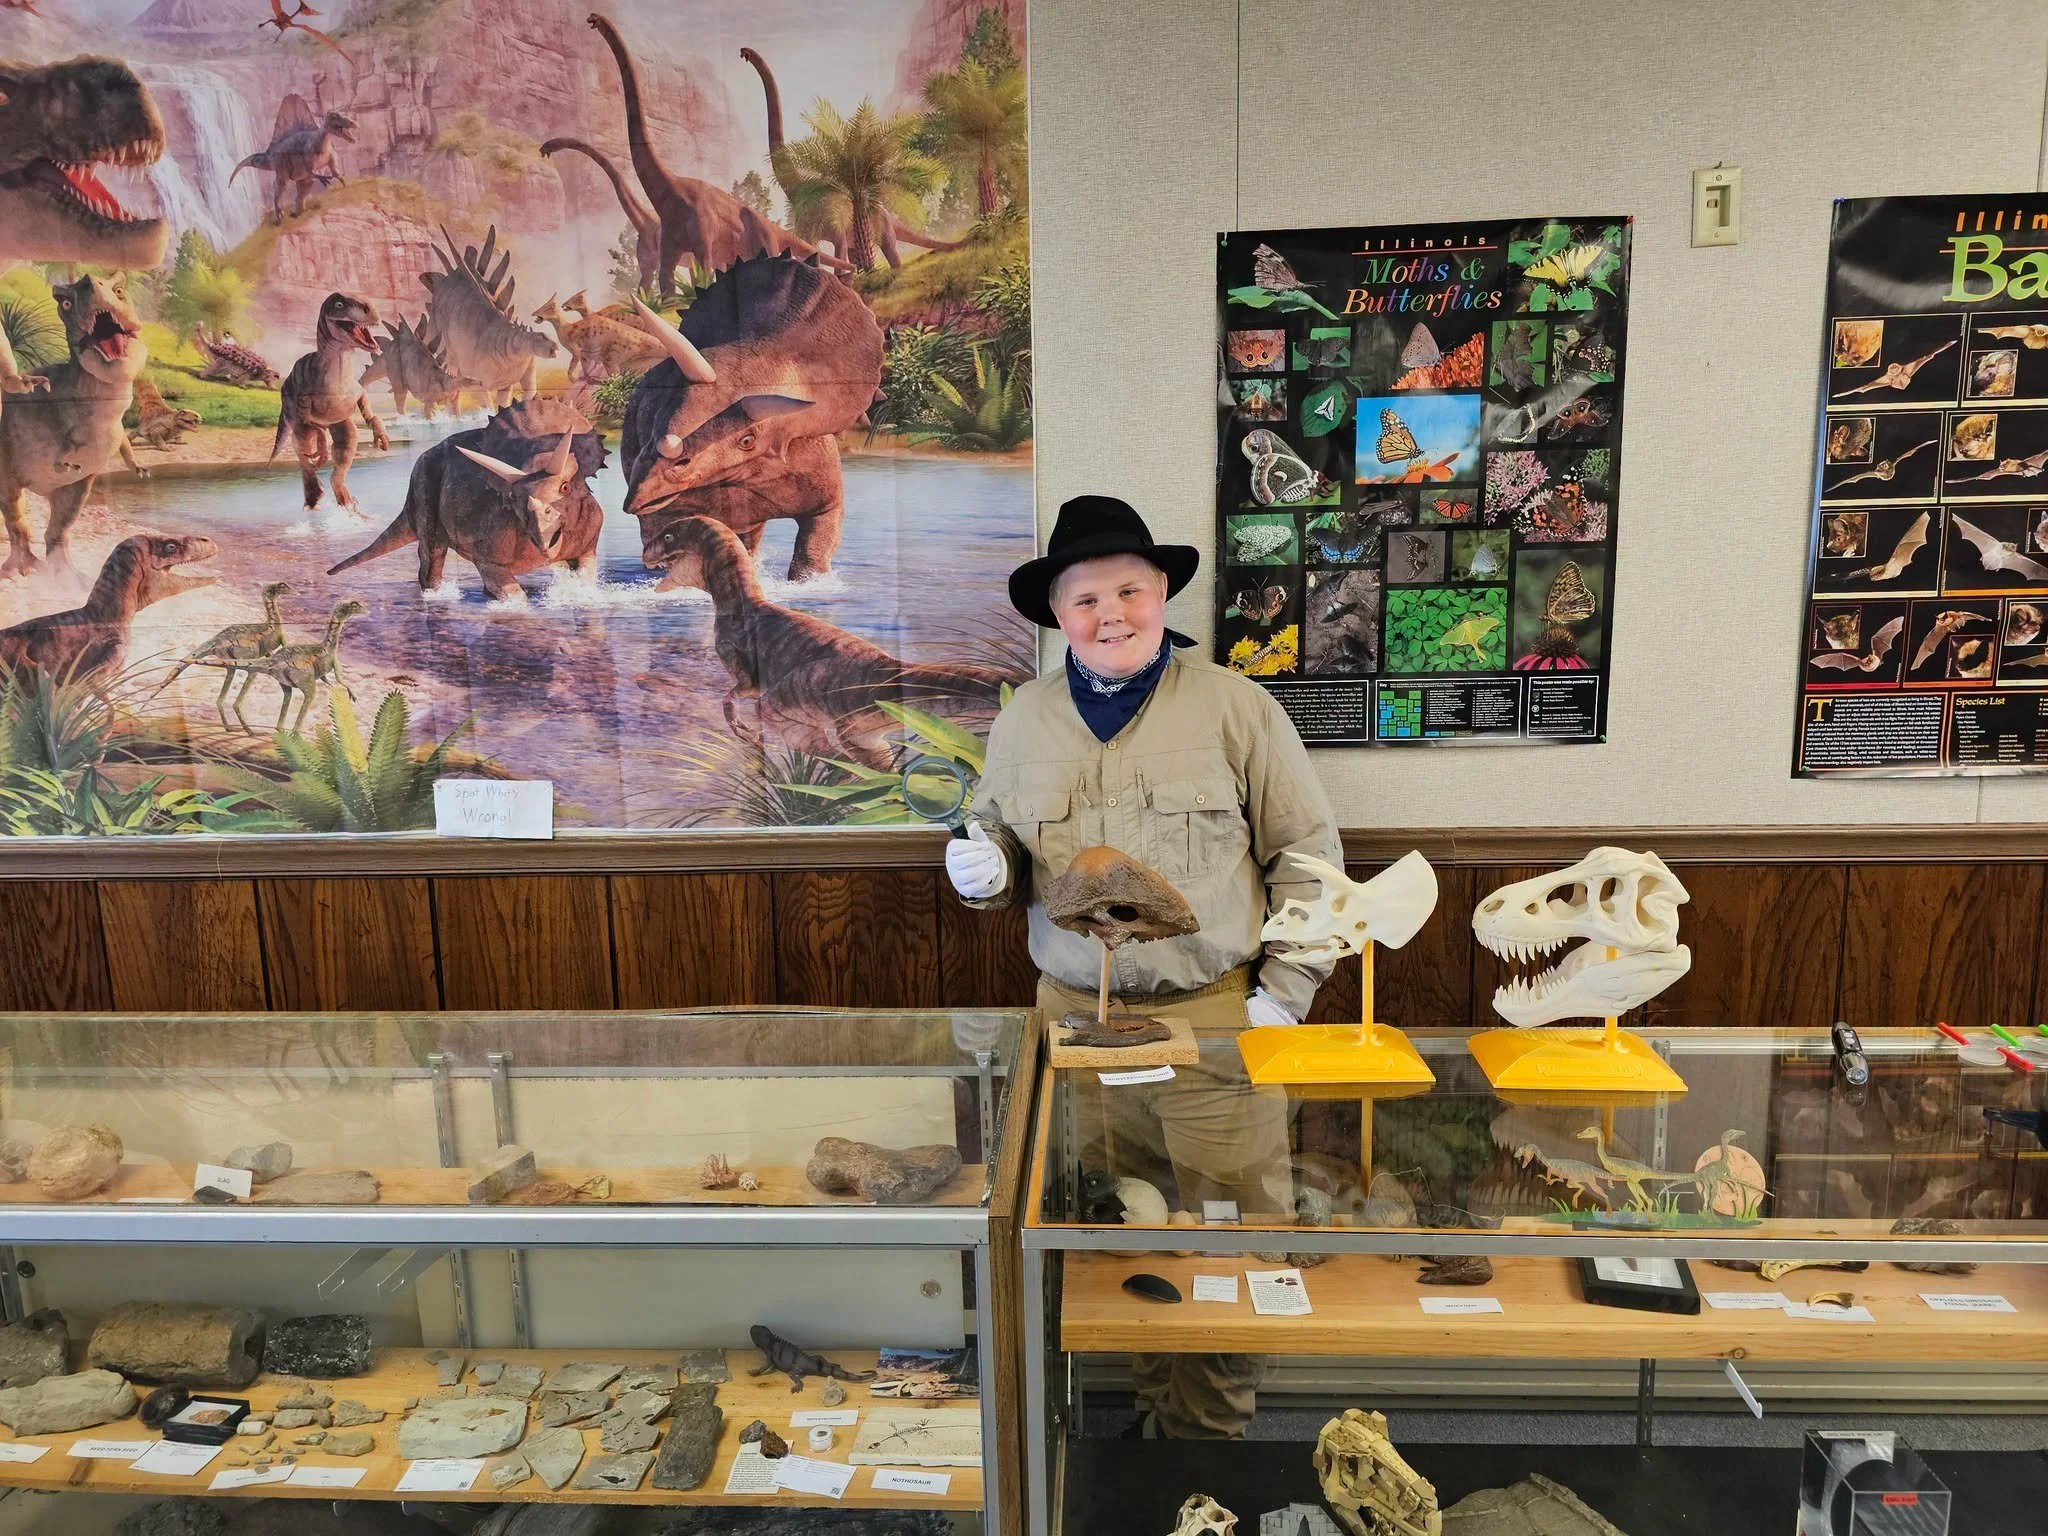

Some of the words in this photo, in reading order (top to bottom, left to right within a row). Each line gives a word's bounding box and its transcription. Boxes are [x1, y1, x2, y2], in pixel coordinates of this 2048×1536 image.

[1365, 236, 1487, 250] Illinois
[1361, 256, 1450, 285] Moths
[1460, 257, 1485, 280] &
[1340, 284, 1503, 318] Butterflies
[1955, 697, 1989, 708] Species
[1989, 697, 2006, 705] List
[455, 784, 479, 804] Spot
[486, 784, 520, 799] What's
[891, 1477, 931, 1485] NOTHOSAUR
